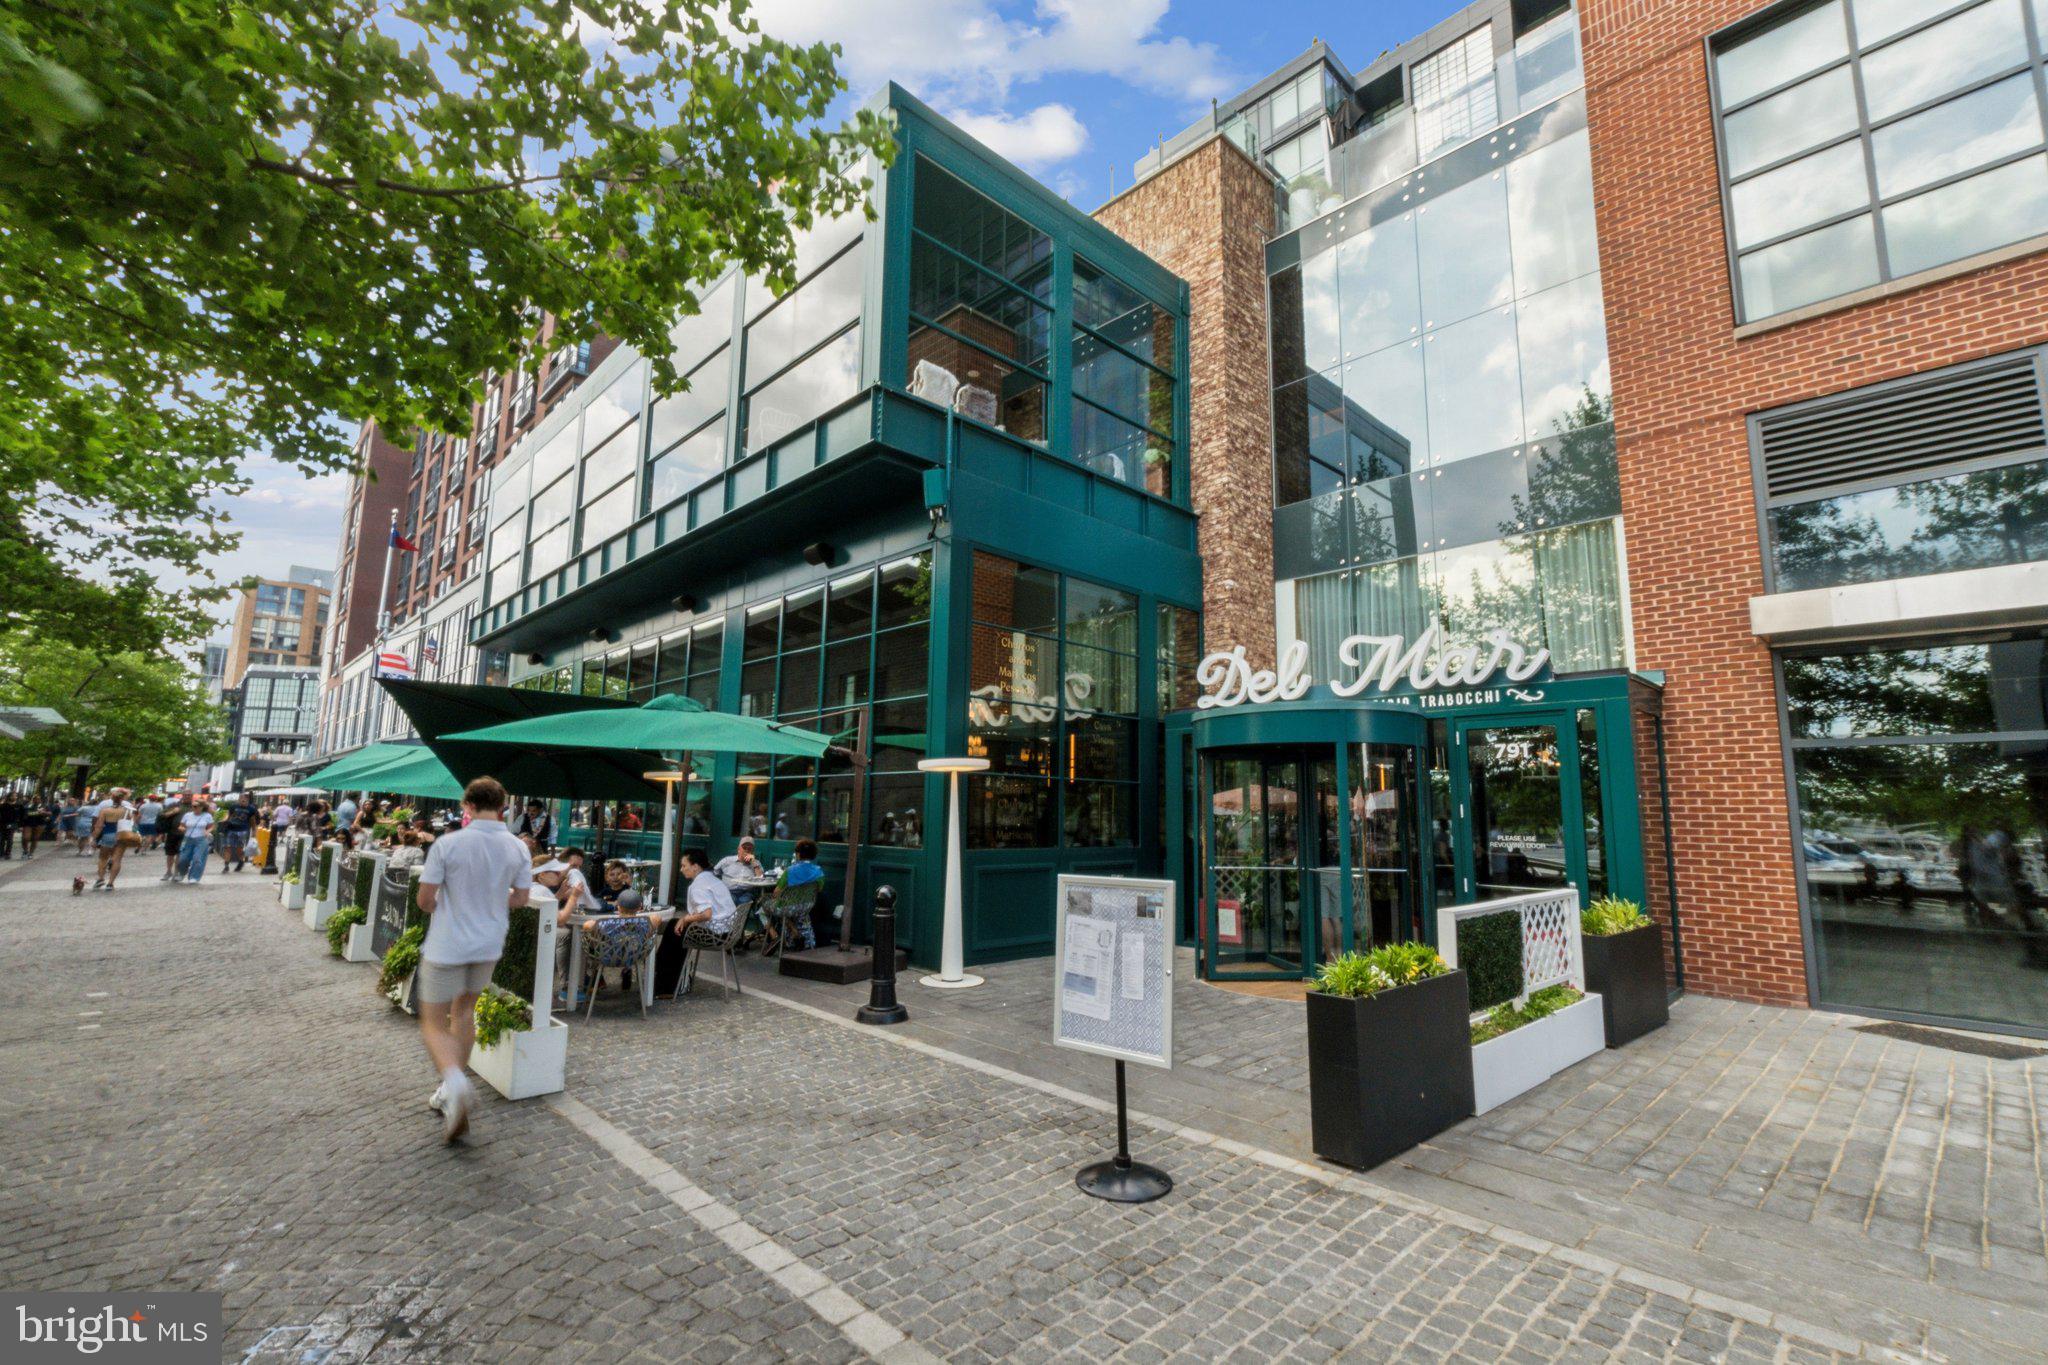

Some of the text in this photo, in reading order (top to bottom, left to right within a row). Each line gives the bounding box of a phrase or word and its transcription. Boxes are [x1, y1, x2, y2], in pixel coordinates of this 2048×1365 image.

[1197, 626, 1550, 708] Del Mar
[1420, 690, 1500, 708] TRABOCCHI
